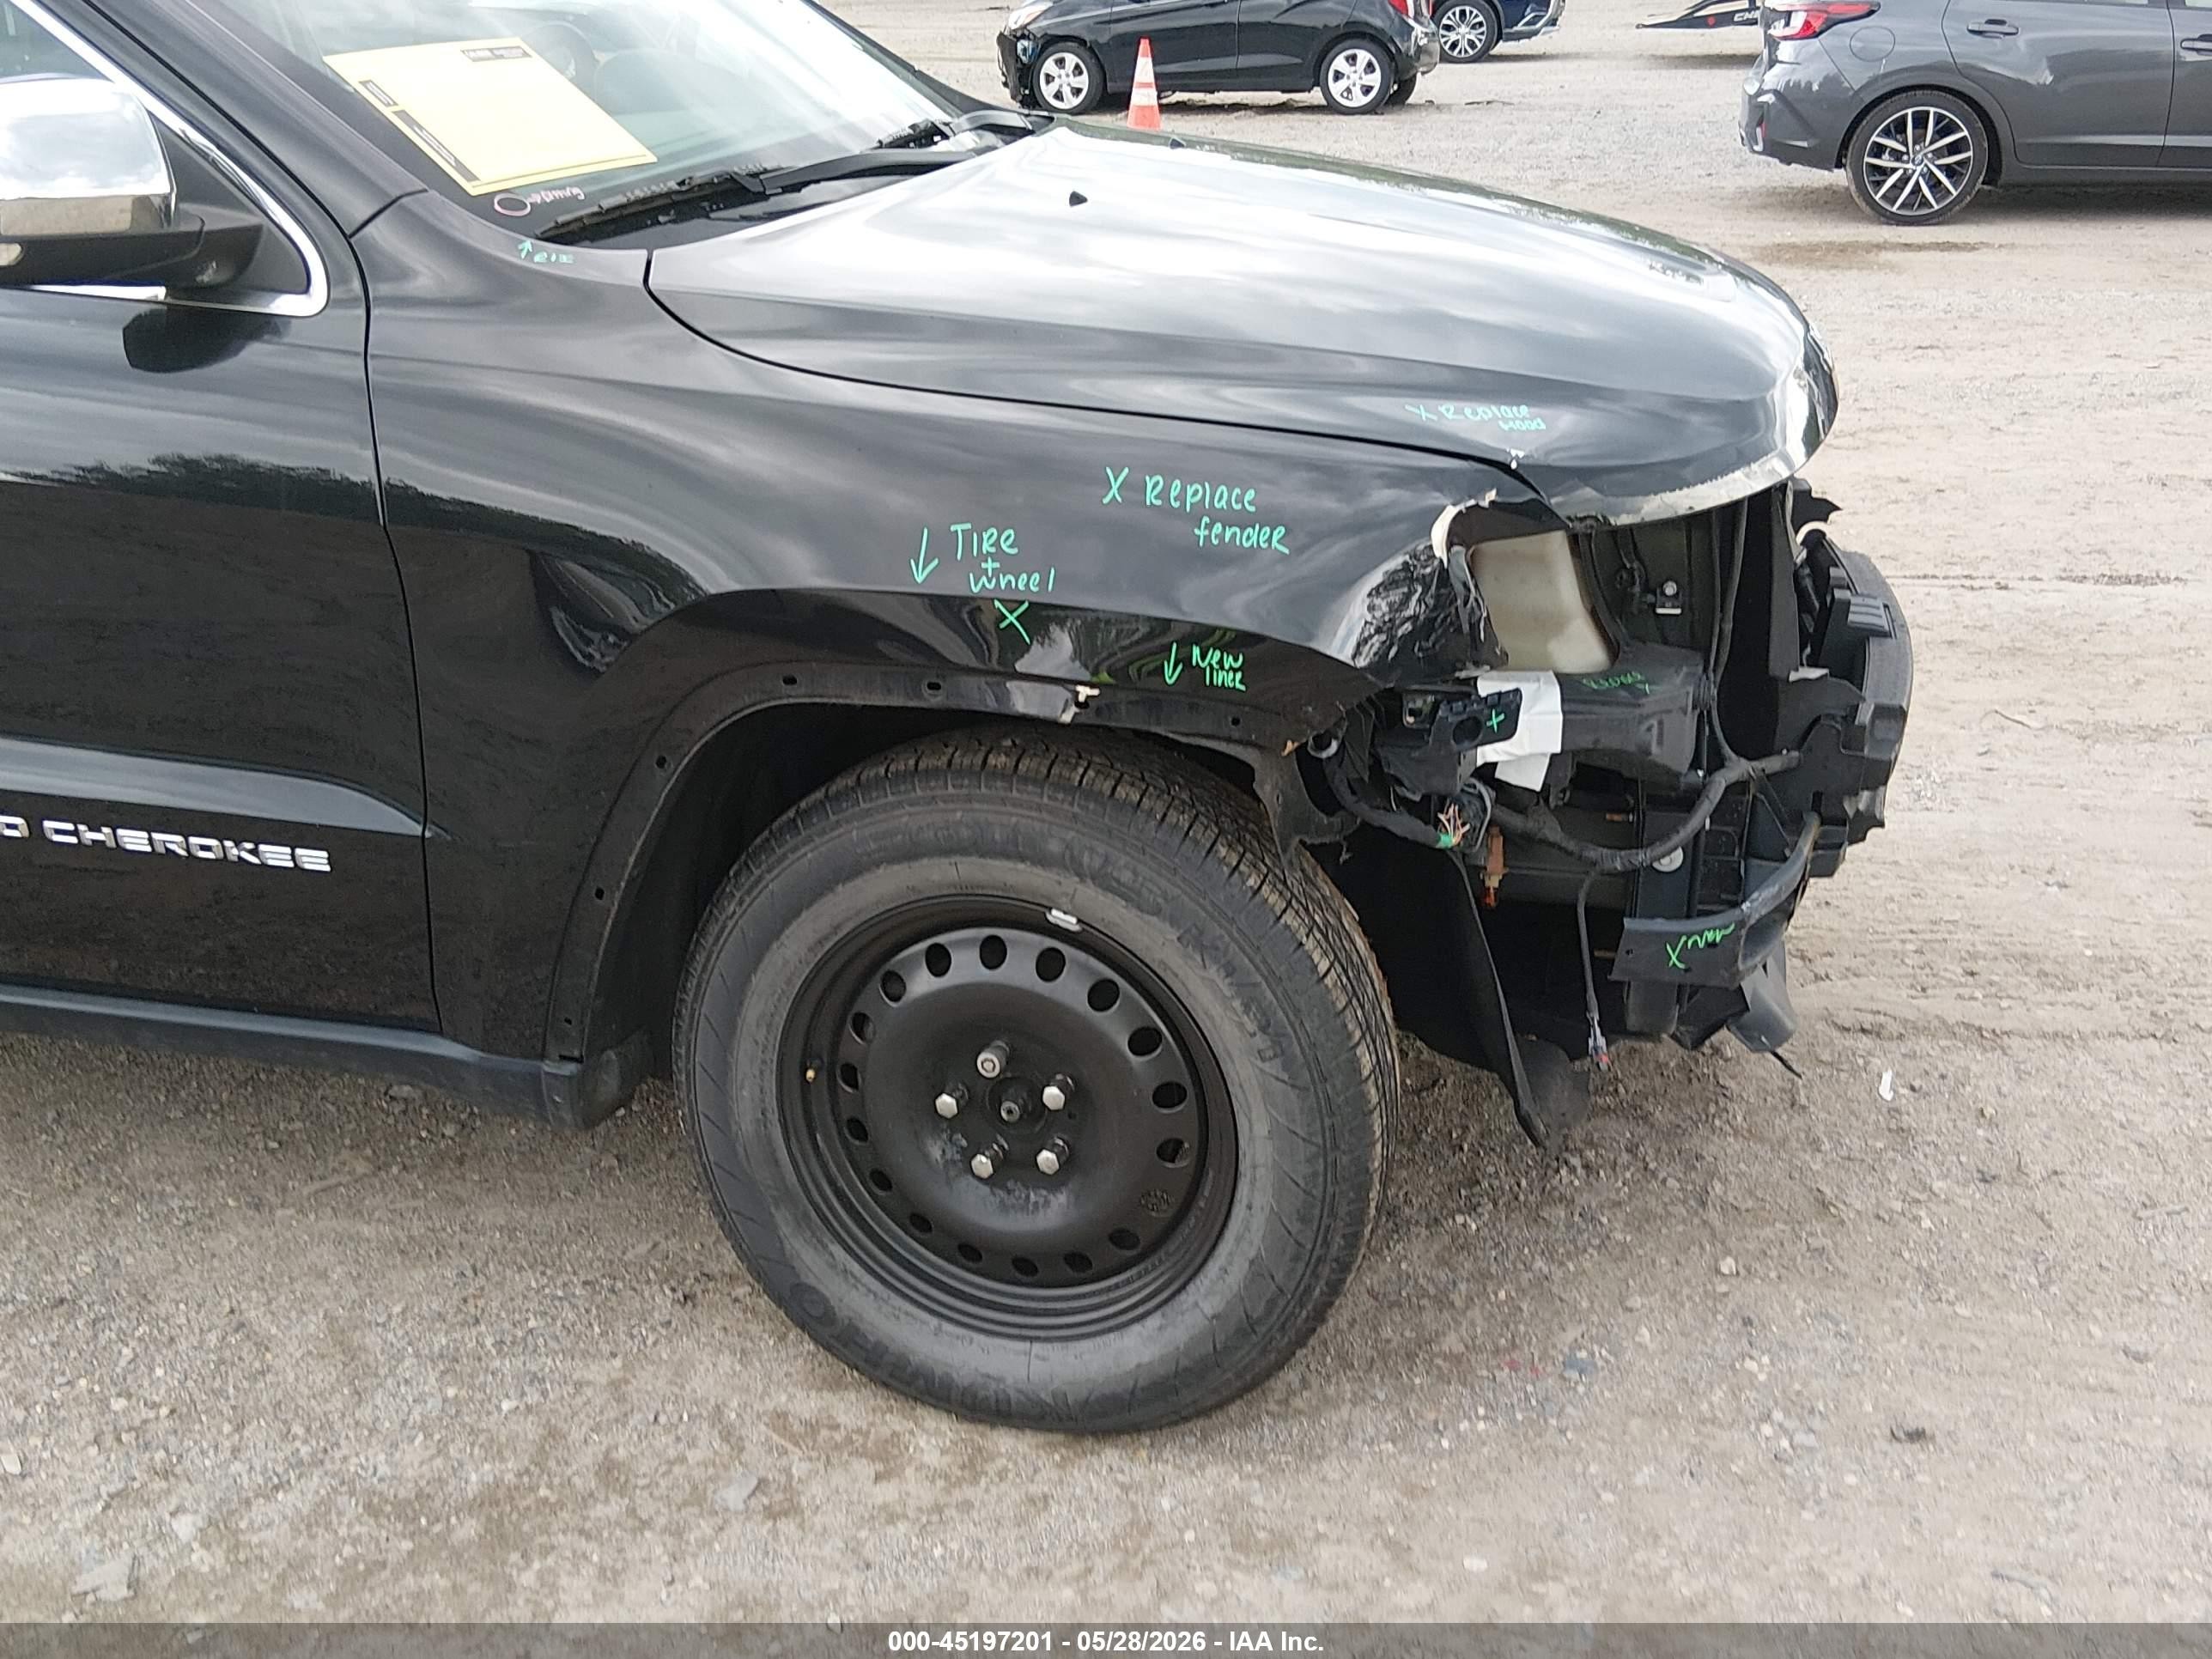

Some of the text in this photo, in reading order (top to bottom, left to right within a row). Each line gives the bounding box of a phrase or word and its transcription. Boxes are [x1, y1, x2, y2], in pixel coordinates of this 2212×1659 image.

[1102, 466, 1256, 514] X Replace
[42, 819, 331, 872] CHEROKEE
